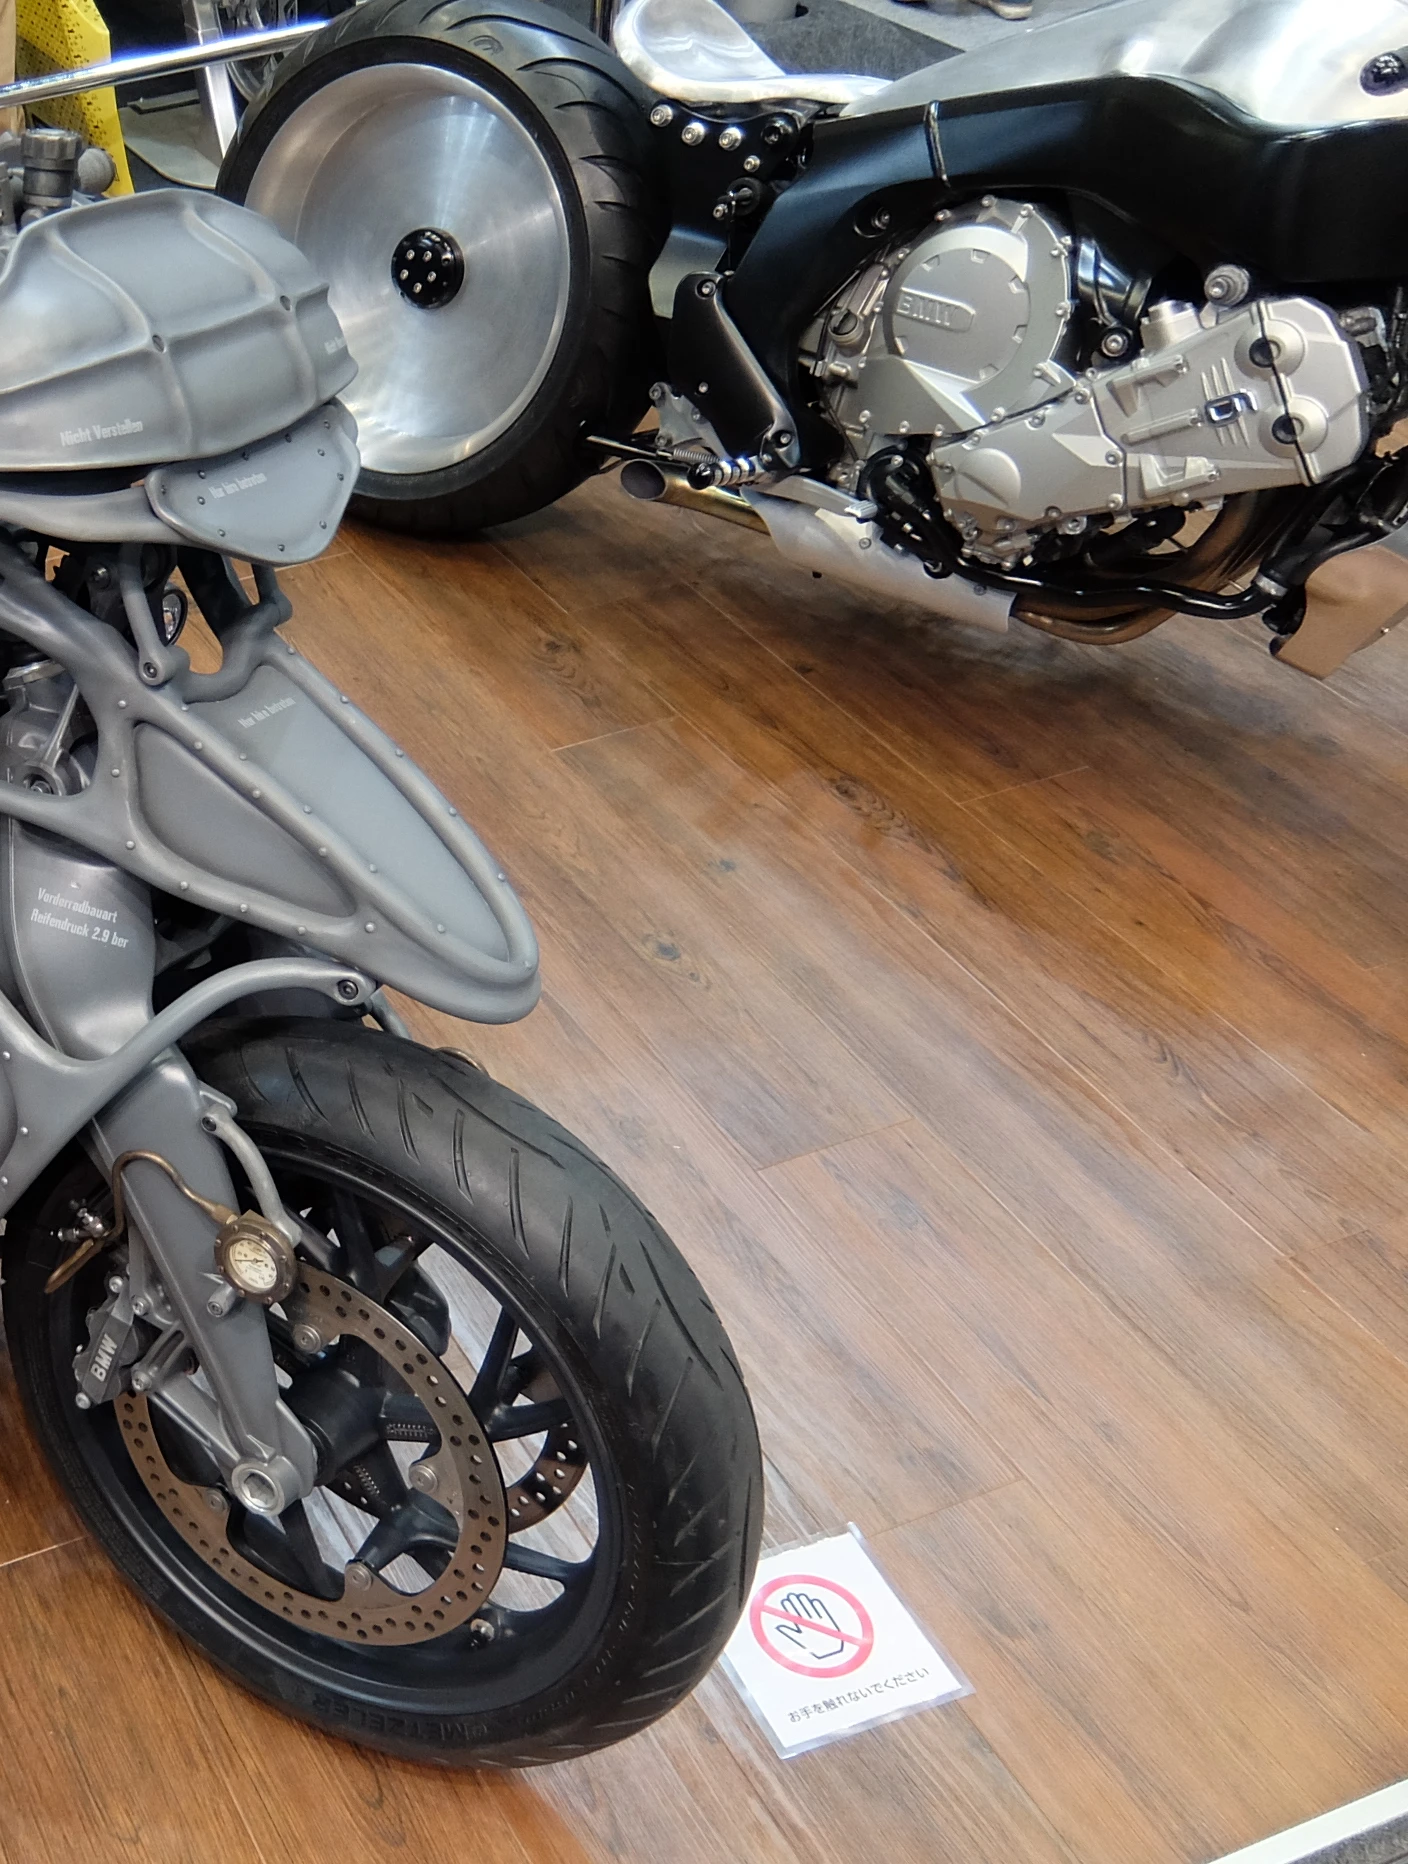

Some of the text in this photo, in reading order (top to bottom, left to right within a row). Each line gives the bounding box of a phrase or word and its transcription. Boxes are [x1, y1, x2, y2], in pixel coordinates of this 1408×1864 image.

[59, 428, 92, 447] Nicht
[37, 887, 118, 923] Vorderradbauart
[30, 908, 90, 938] Reifendruck
[91, 927, 110, 943] 2.9
[90, 1333, 118, 1382] BMW
[787, 1666, 931, 1723] お手を触れないでください
